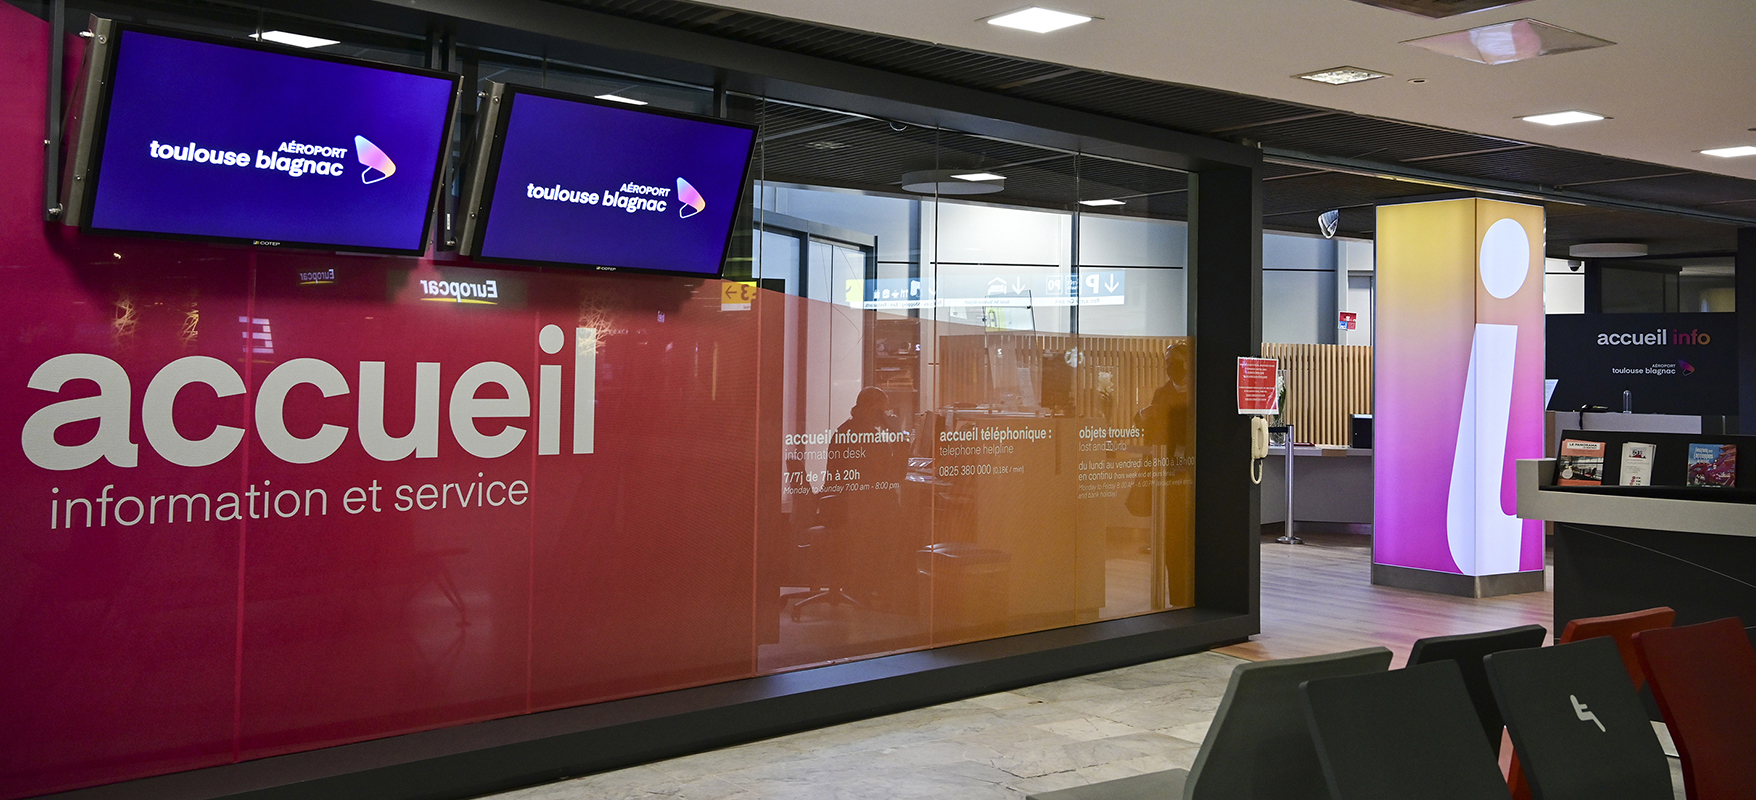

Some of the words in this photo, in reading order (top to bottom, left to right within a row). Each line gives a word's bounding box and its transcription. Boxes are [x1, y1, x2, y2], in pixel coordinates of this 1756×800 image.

[278, 141, 347, 159] AÉROPORT
[150, 140, 250, 167] toulouse
[255, 150, 344, 177] blagnac
[620, 182, 670, 197] AÉROPORT
[527, 183, 599, 205] toulouse
[602, 190, 667, 213] blagnac
[1597, 328, 1667, 346] accueil
[1673, 328, 1711, 346] info
[1612, 367, 1644, 375] toulouse
[1645, 367, 1676, 376] blagnac
[21, 323, 596, 471] accueil
[785, 430, 832, 445] accueil
[835, 429, 903, 443] information
[940, 427, 979, 442] accueil
[980, 426, 1047, 443] téléphonique
[1079, 426, 1107, 441] objets
[1108, 425, 1140, 438] trouvés
[785, 449, 841, 460] information
[843, 447, 866, 458] desk
[939, 445, 982, 457] telephone
[982, 443, 1014, 456] helpline
[1078, 442, 1092, 452] lost
[939, 466, 959, 477] 0825
[960, 465, 976, 476] 380
[976, 464, 992, 475] 000
[1079, 461, 1088, 471] du
[1088, 460, 1105, 470] lundi
[1106, 460, 1115, 469] au
[1115, 458, 1143, 469] vendredi
[1143, 457, 1152, 467] de
[1152, 457, 1170, 467] 8h00
[783, 471, 804, 485] 7/7j
[805, 470, 819, 482] de
[820, 470, 833, 482] 7h
[834, 469, 841, 481] à
[843, 469, 861, 481] 20h
[1078, 473, 1087, 481] en
[1088, 471, 1113, 480] continu
[50, 480, 328, 530] information
[341, 480, 383, 513] et
[394, 472, 530, 509] service
